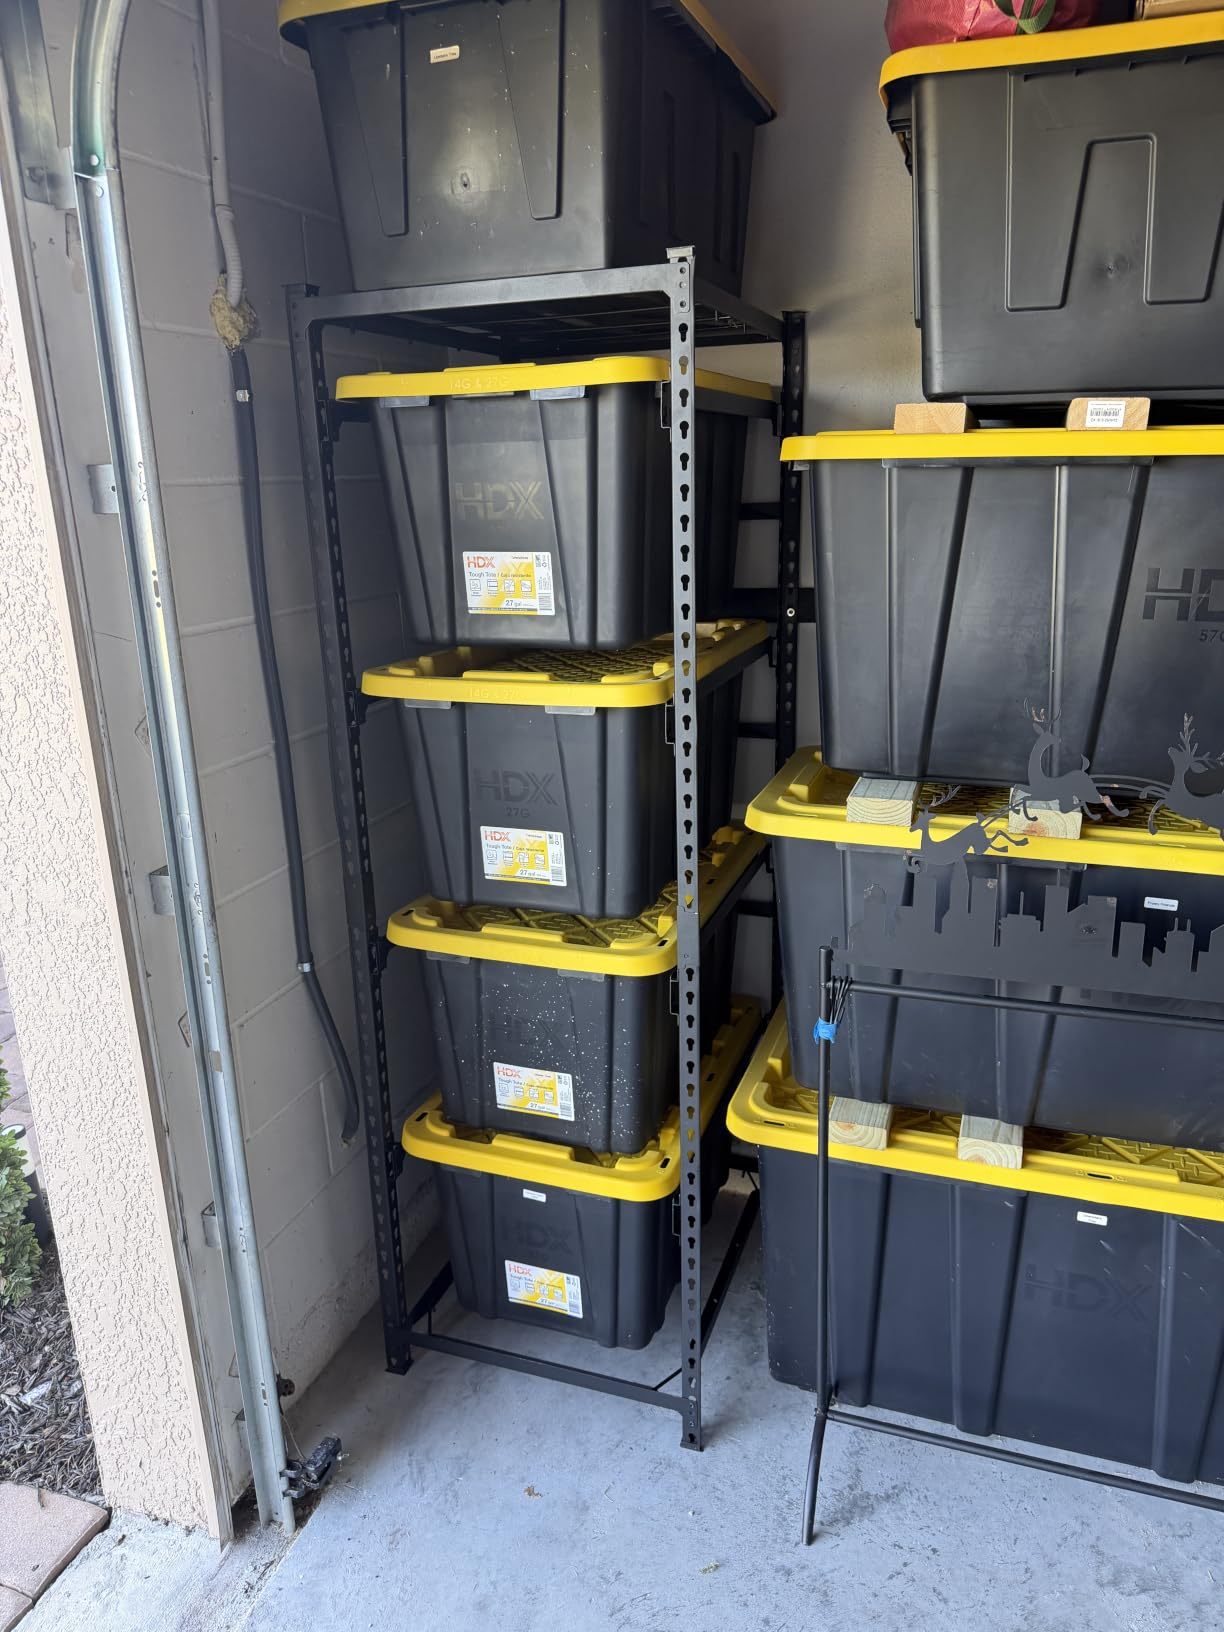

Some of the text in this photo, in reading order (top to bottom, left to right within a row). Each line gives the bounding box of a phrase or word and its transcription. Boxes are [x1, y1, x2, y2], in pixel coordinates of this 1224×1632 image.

[455, 481, 545, 520] HDX
[467, 555, 496, 568] HDX
[1142, 567, 1224, 622] HD
[505, 599, 514, 607] 27
[473, 767, 559, 806] HDX
[505, 807, 529, 818] 27G
[484, 830, 511, 842] HDX
[497, 1066, 521, 1079] HDX
[501, 1215, 575, 1256] HDX
[508, 1263, 532, 1276] HDX
[1024, 1263, 1151, 1322] HDX
